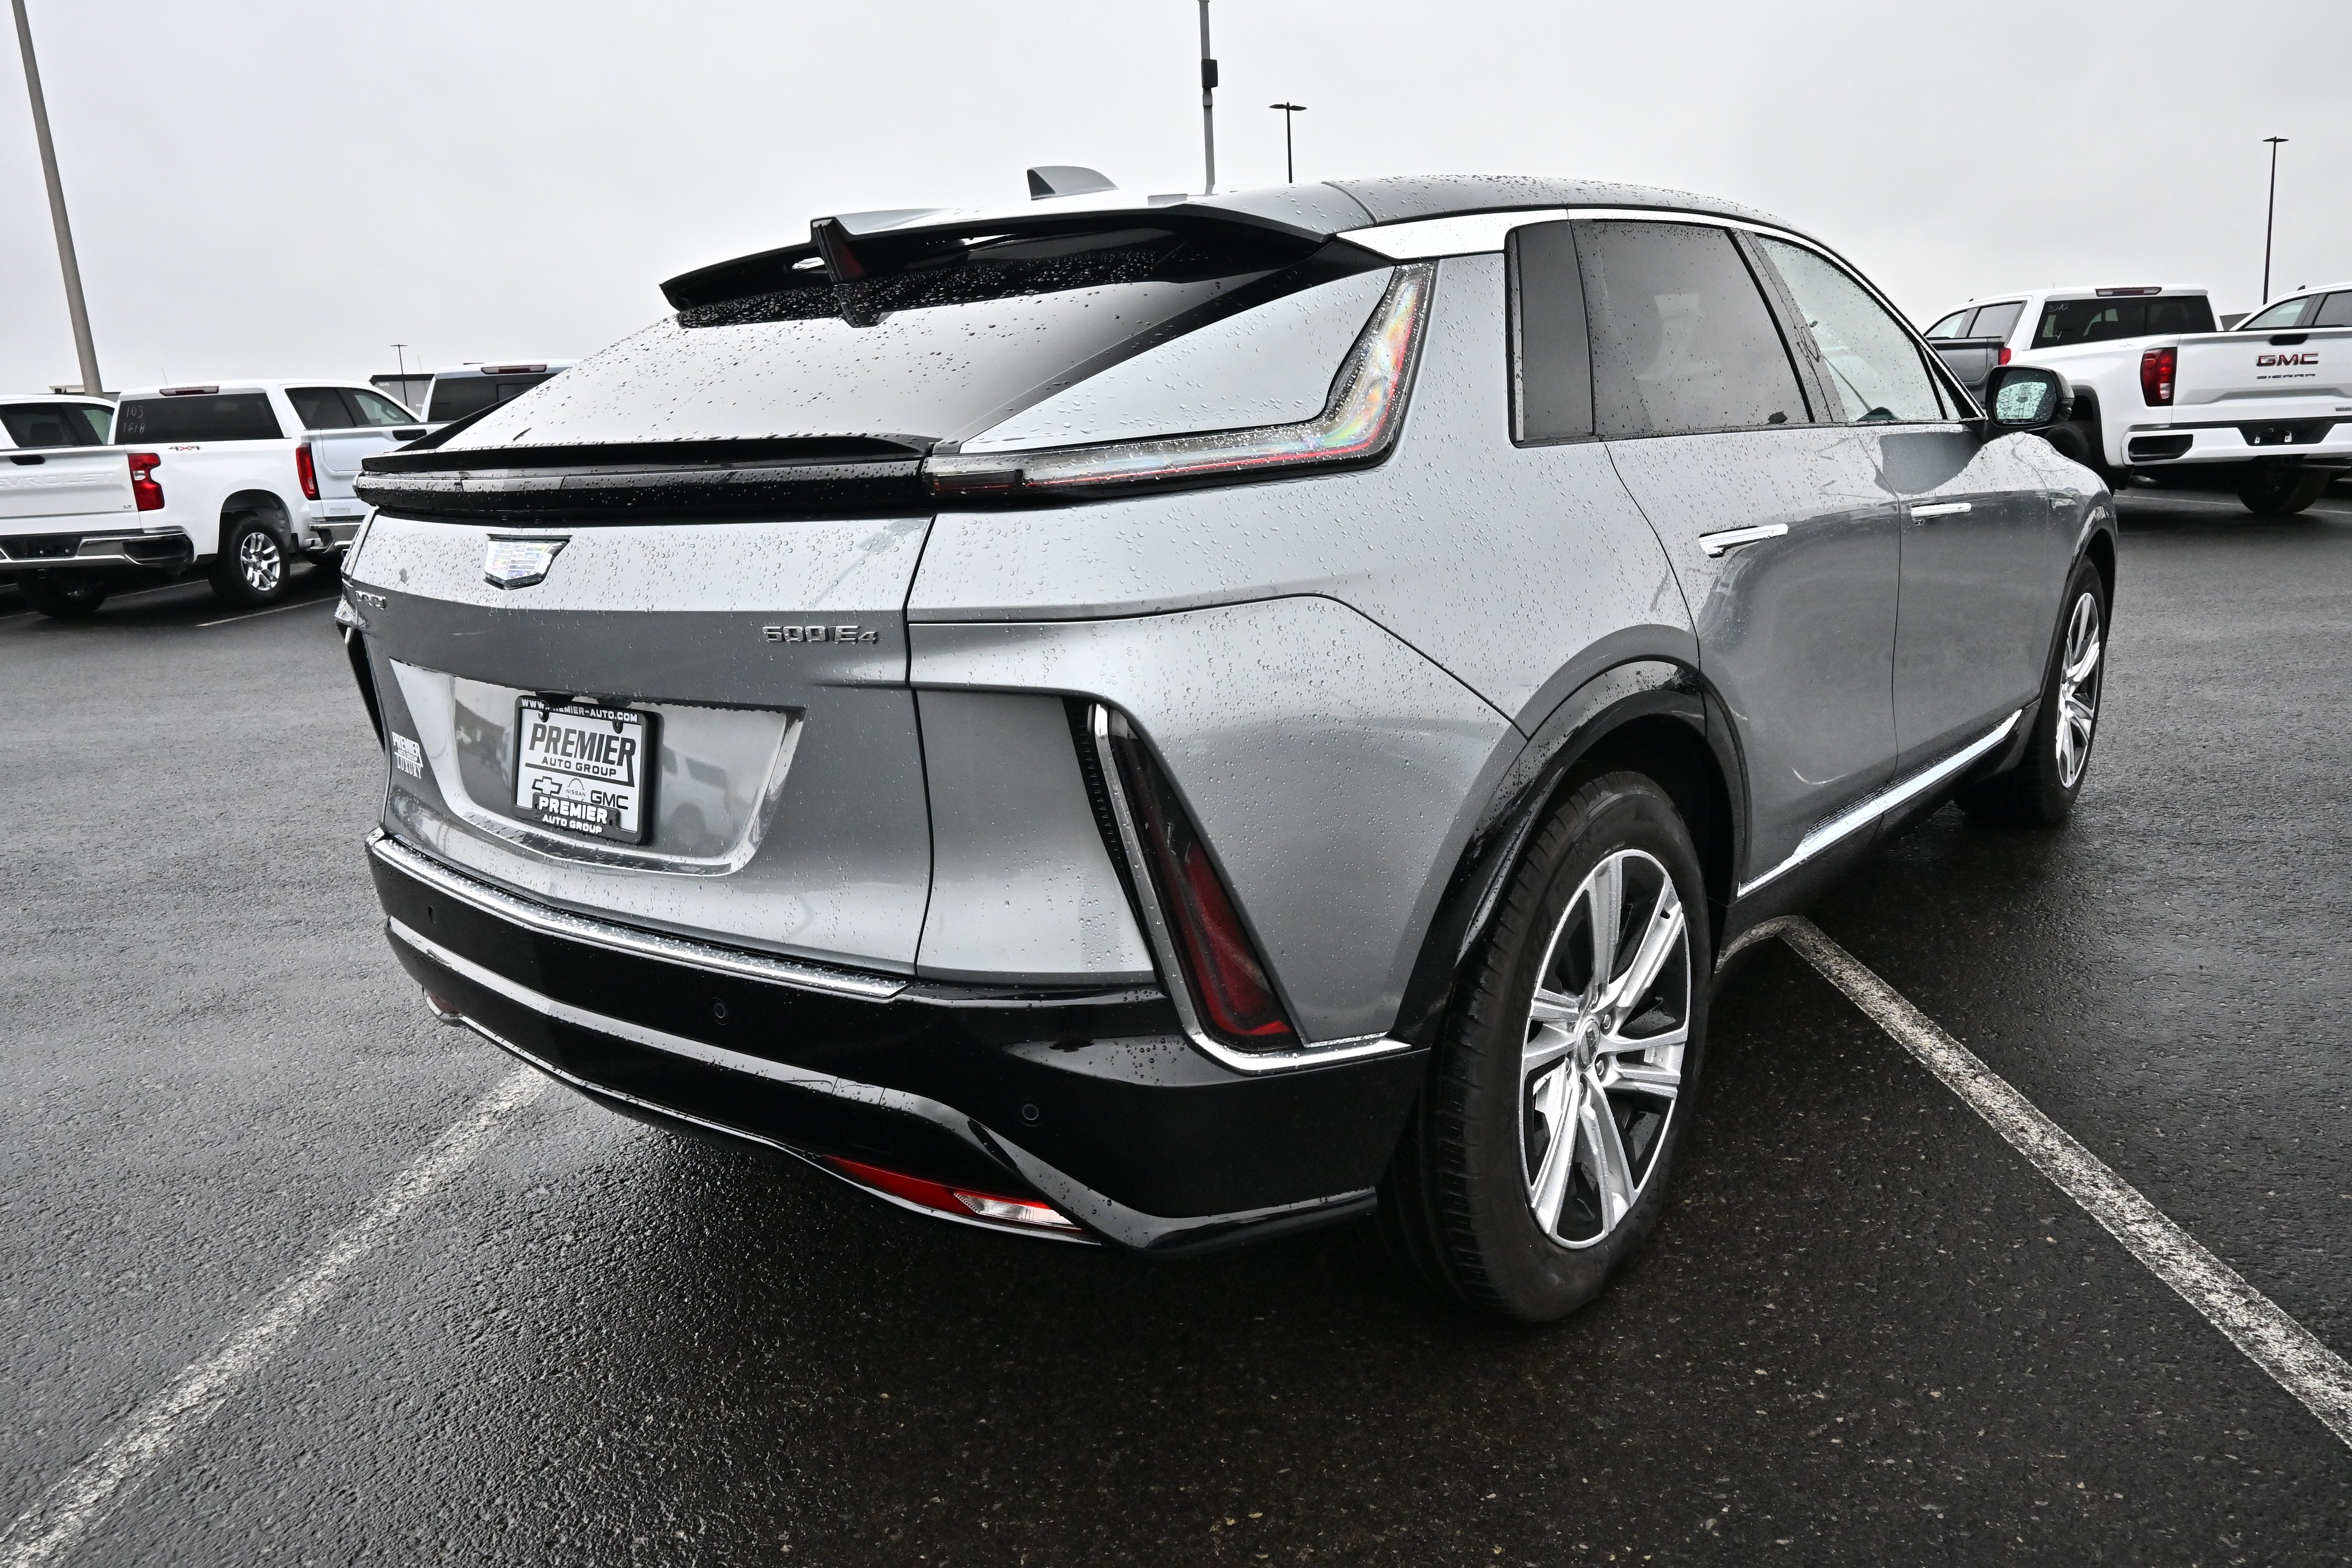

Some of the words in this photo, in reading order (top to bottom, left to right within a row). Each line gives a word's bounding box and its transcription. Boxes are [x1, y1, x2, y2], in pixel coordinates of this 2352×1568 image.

[2256, 352, 2319, 367] GMC
[126, 406, 144, 419] 103
[123, 422, 145, 433] 1618
[529, 723, 636, 767] PREMIER
[397, 755, 422, 779] LUXURY
[542, 756, 572, 769] AUTO
[575, 762, 617, 777] GROUP
[566, 789, 586, 797] NISSAN
[591, 789, 629, 810] GMC
[539, 796, 608, 824] PREMIER
[542, 814, 567, 827] AUTO
[569, 819, 602, 834] GROUP
